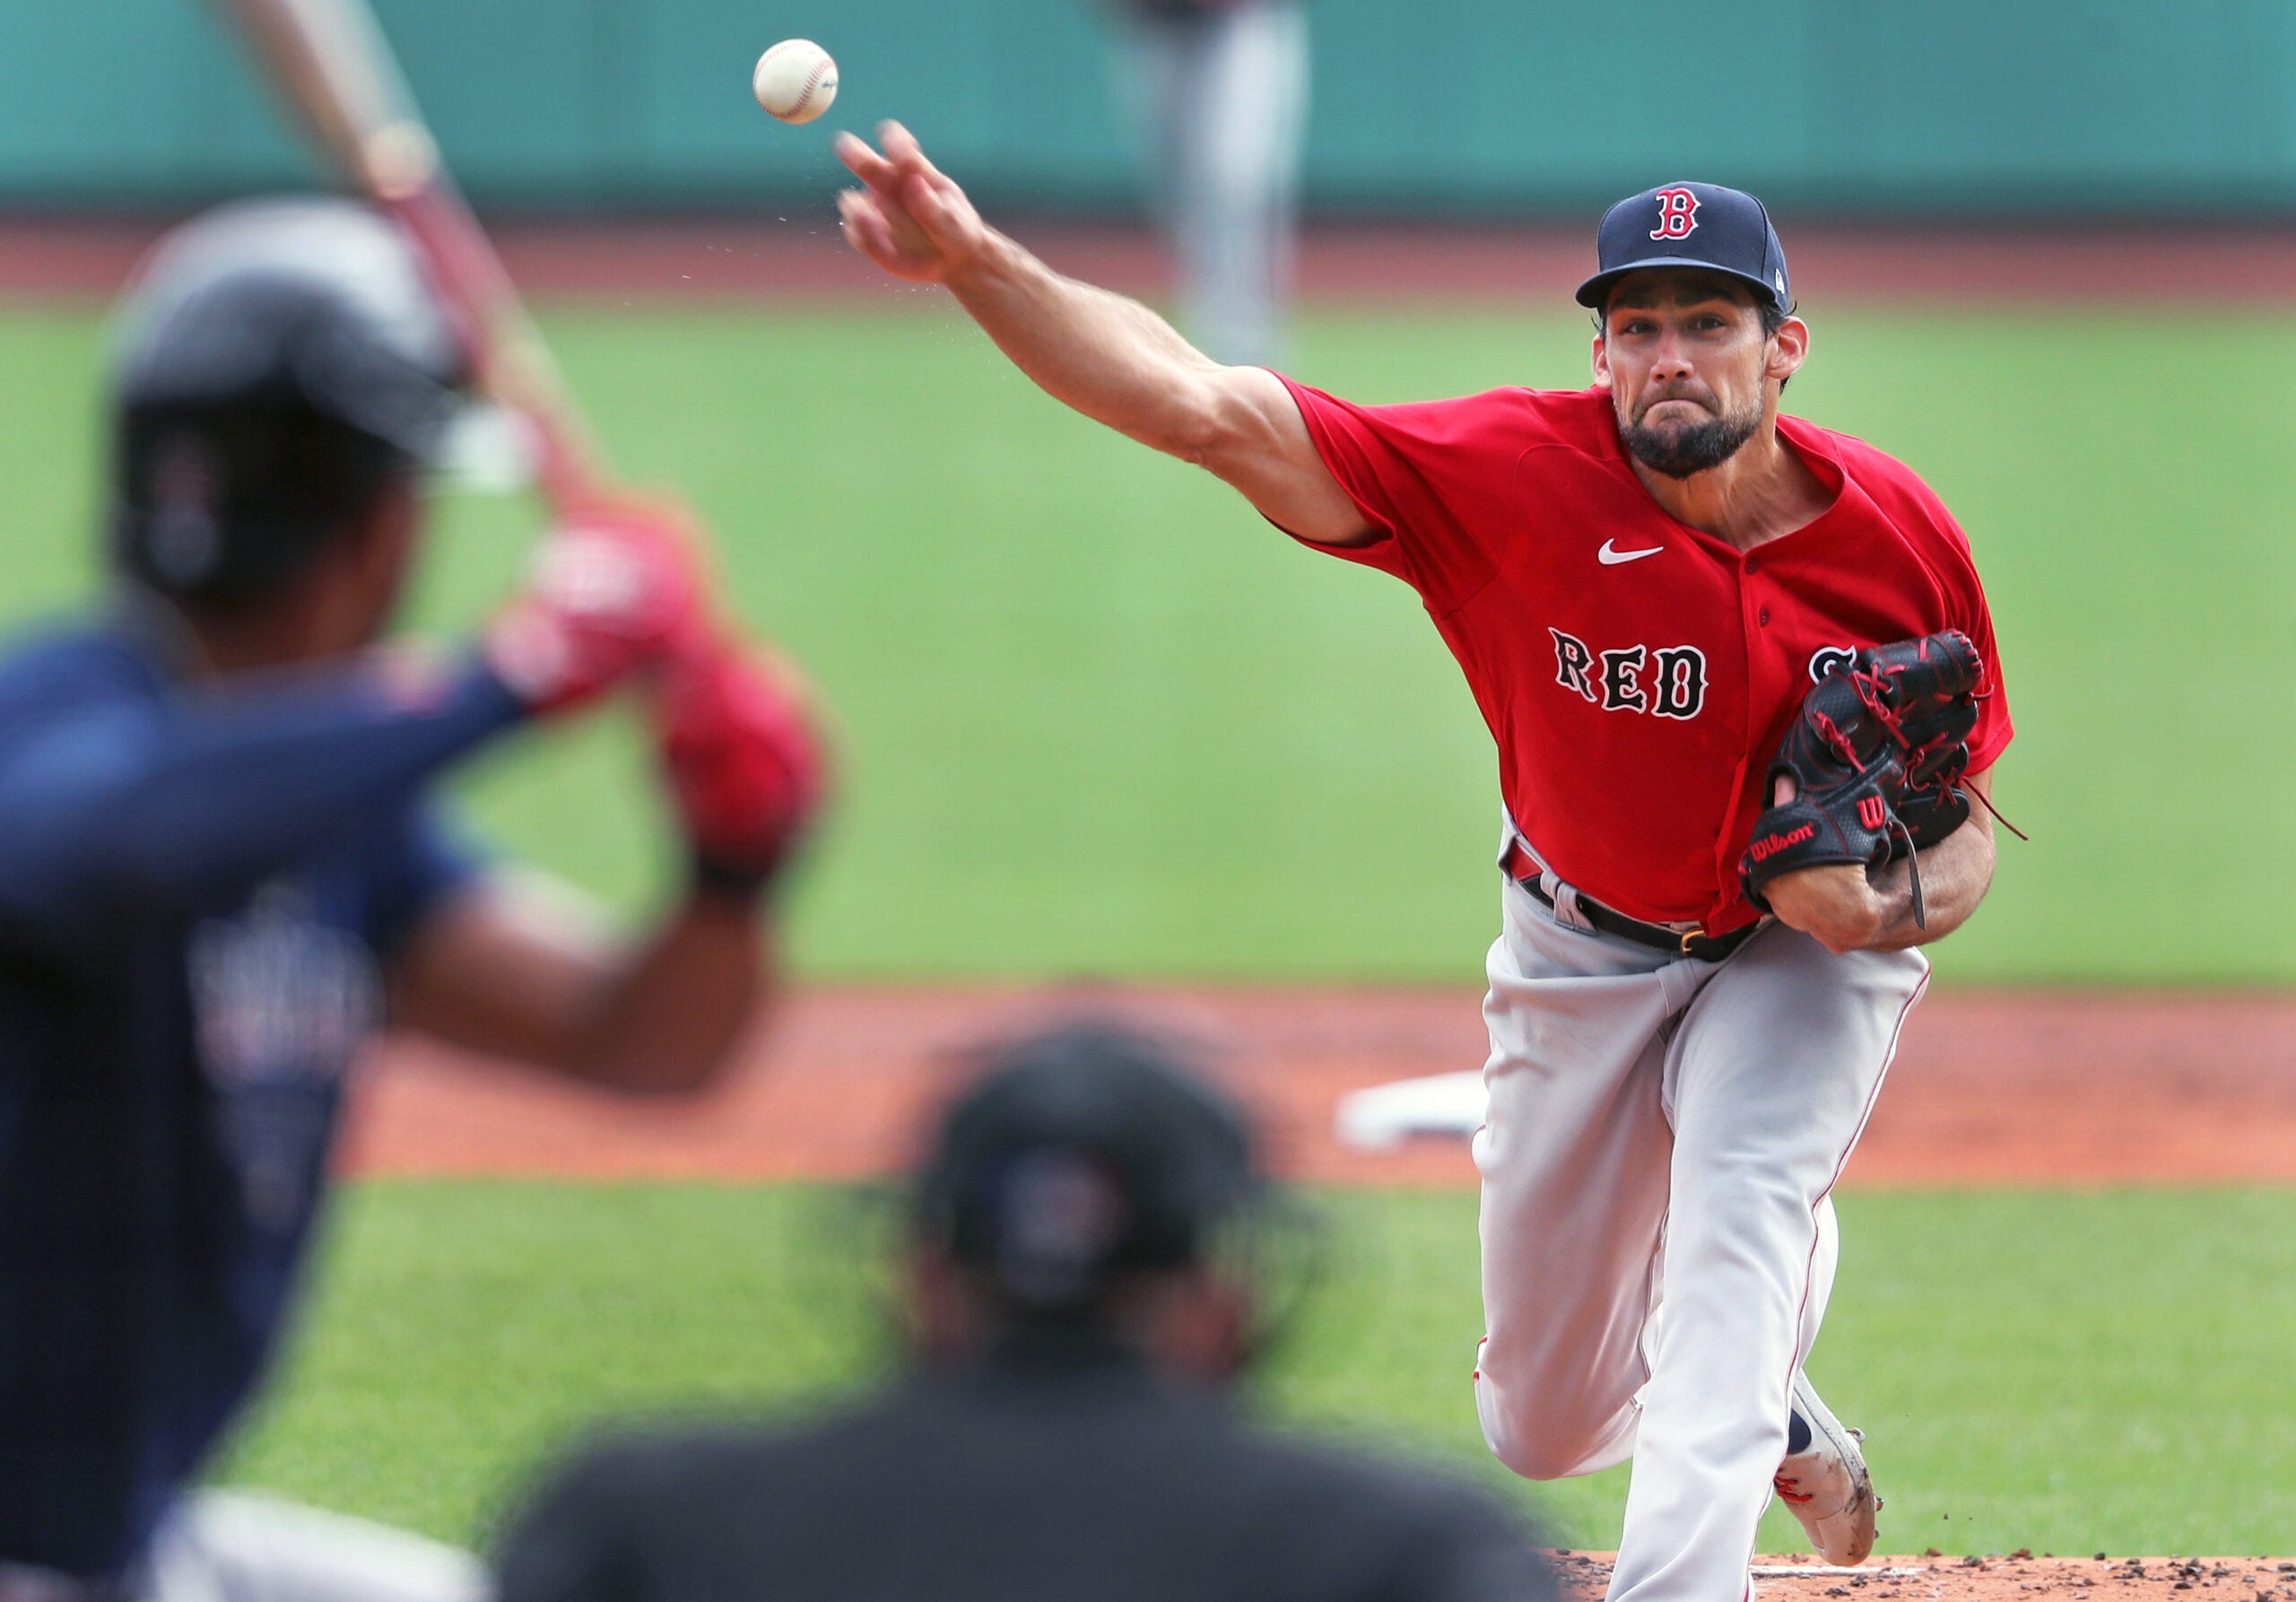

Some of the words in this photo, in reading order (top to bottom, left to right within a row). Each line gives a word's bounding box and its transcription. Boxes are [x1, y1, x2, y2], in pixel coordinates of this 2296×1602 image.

[1650, 187, 1700, 240] B
[1548, 627, 1709, 720] RED
[1857, 796, 1884, 830] W
[1751, 822, 1814, 862] Wilson
